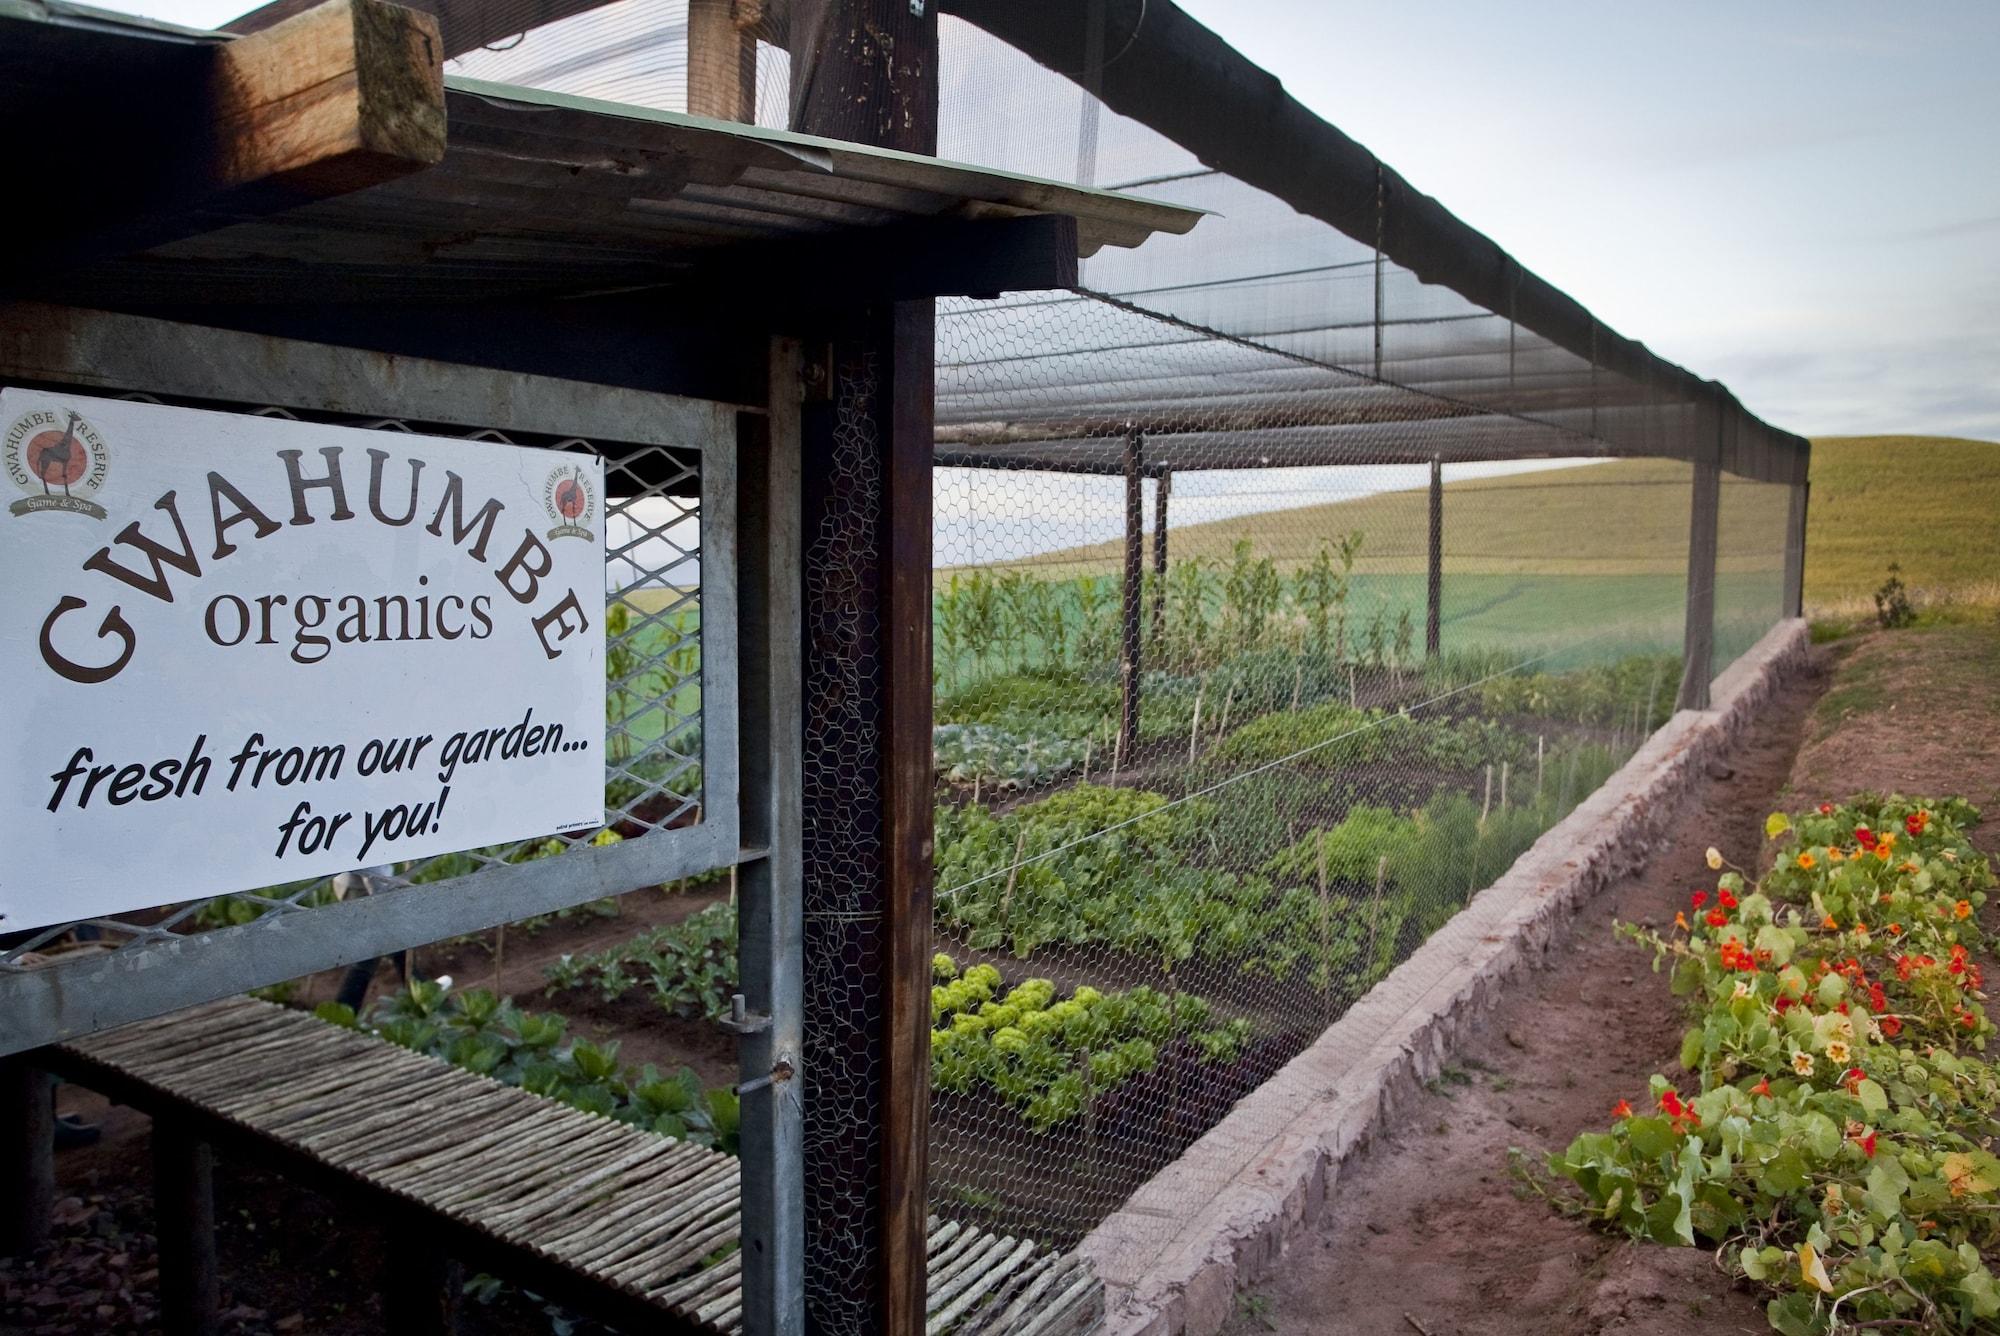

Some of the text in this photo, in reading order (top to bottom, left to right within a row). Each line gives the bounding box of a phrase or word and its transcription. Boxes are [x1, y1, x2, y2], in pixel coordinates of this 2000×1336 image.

[6, 411, 55, 485] GWAHUMBE
[76, 422, 107, 490] RESERVE
[27, 499, 57, 511] Game
[73, 500, 93, 513] Spa
[545, 464, 569, 519] GWAHUMBE
[578, 472, 595, 521] RESERVE
[39, 446, 589, 684] GWAHUMBE
[204, 576, 493, 664] organics
[46, 708, 588, 812] fresh from our garden...
[275, 787, 450, 861] for you!
